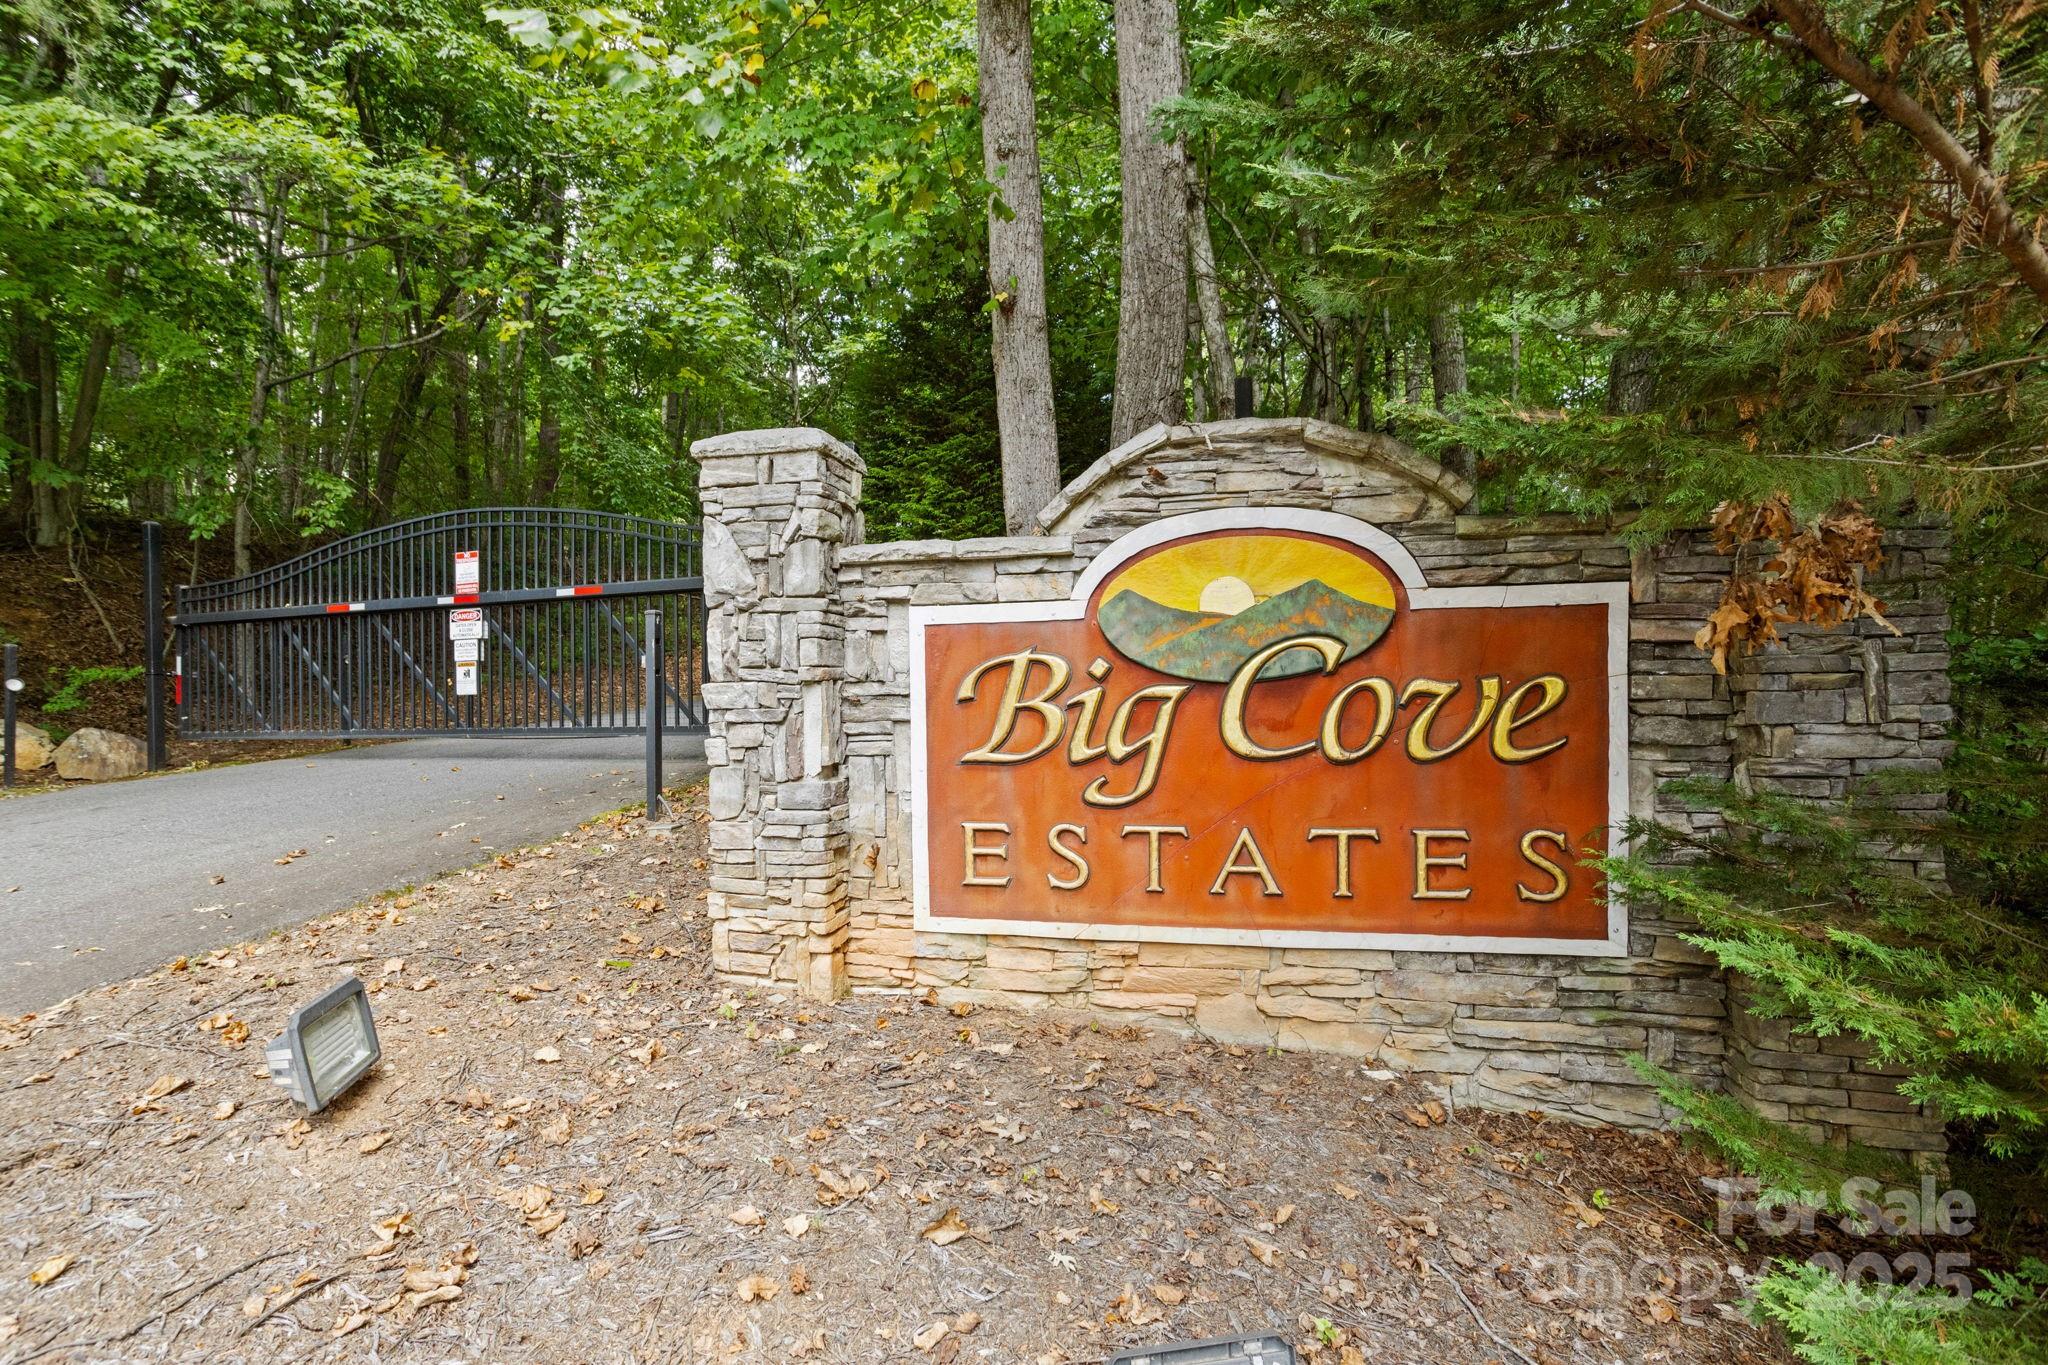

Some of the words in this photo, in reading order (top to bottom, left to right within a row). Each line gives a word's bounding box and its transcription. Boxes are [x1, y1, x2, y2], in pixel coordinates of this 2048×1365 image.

[454, 612, 478, 620] DANGER
[956, 645, 1193, 809] Big
[1219, 633, 1570, 766] Cove
[960, 821, 1571, 902] ESTATES
